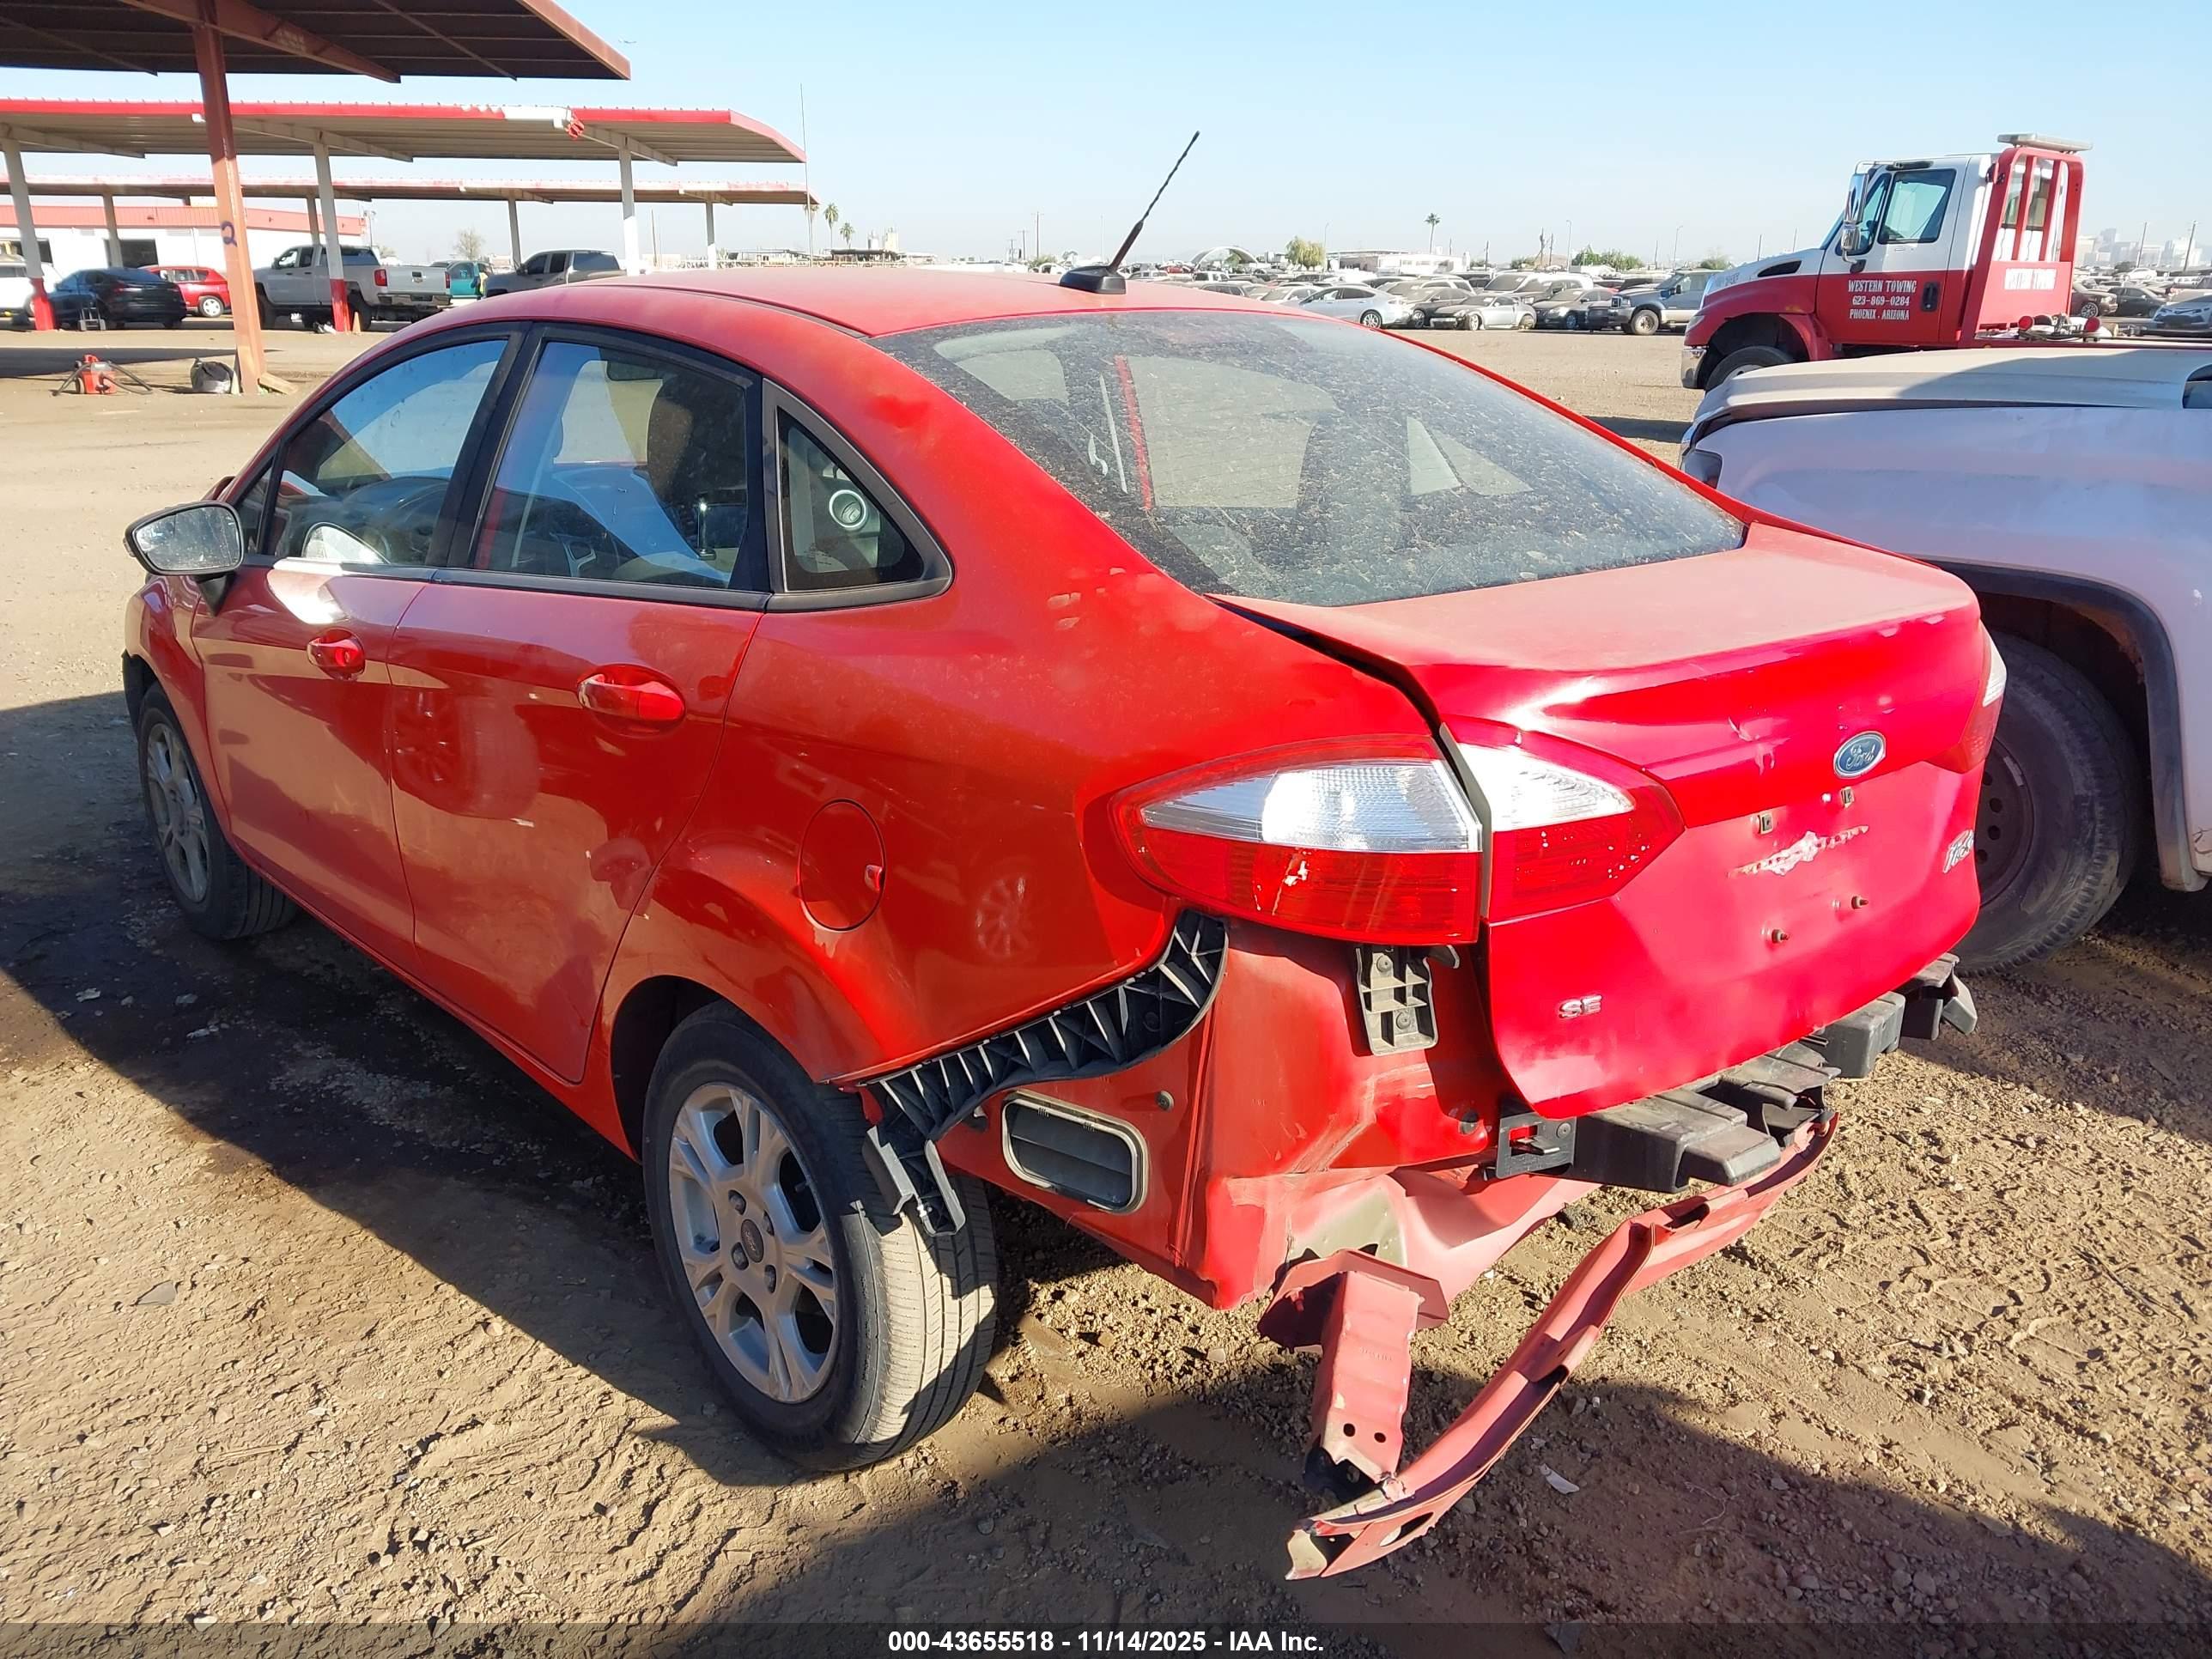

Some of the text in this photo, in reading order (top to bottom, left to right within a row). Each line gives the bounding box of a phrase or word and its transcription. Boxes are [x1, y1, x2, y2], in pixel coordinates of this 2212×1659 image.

[220, 221, 238, 247] 2
[1848, 279, 1917, 293] WESTERN TOWING
[1852, 295, 1911, 307] 623-869-0284
[1850, 309, 1877, 319] PHOENIX
[1881, 309, 1910, 320] ARIZONA
[1559, 994, 1602, 1019] SE
